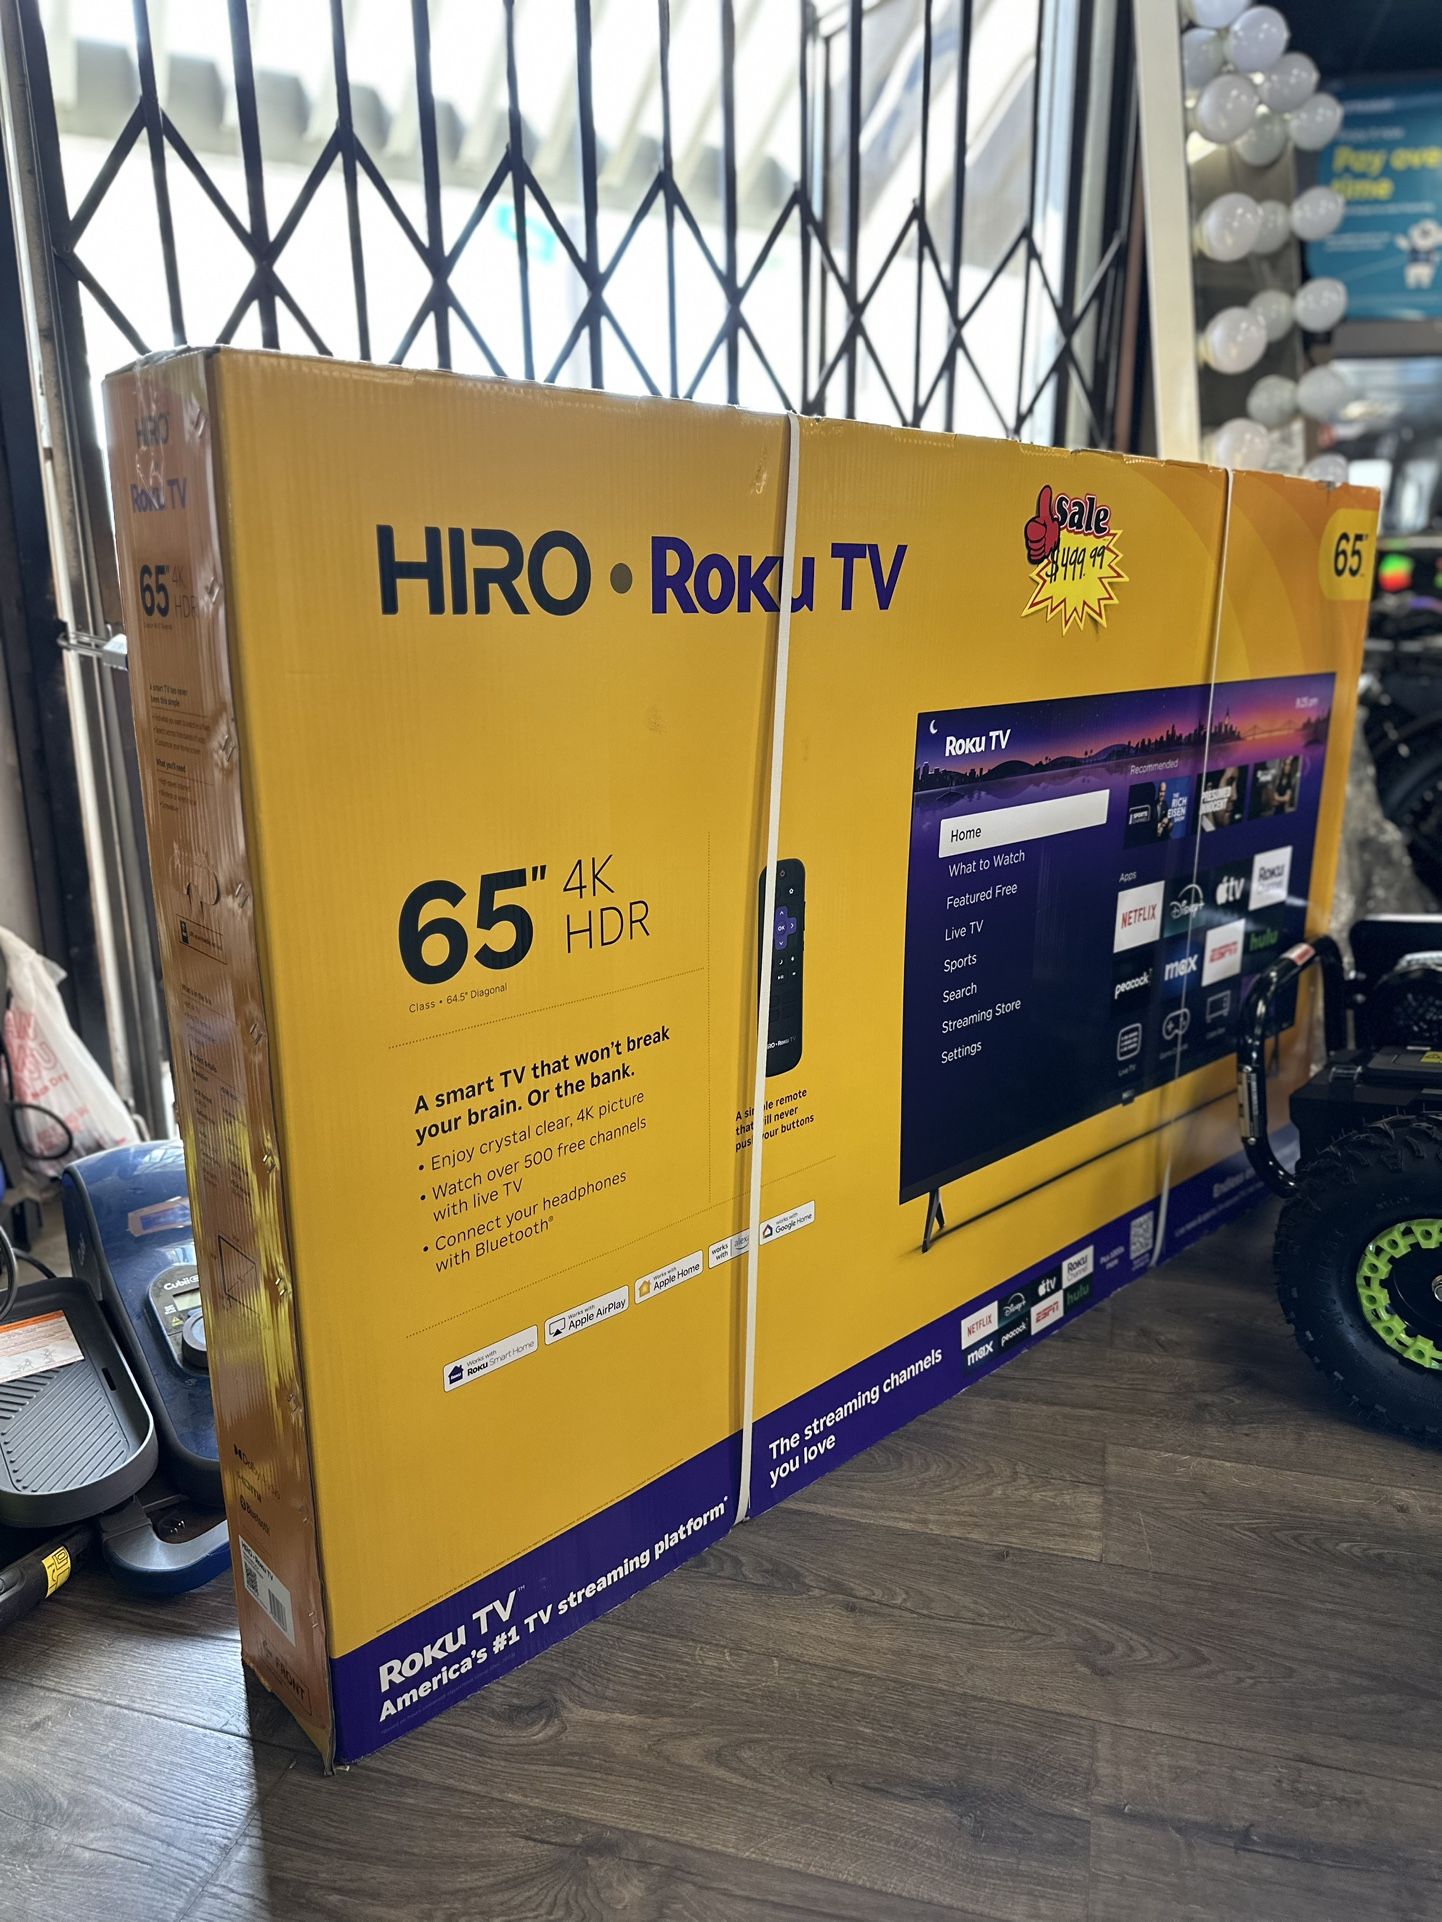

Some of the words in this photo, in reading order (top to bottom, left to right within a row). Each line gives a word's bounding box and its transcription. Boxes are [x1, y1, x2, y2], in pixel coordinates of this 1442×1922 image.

[1333, 146, 1386, 177] Pay
[1391, 145, 1442, 171] ove
[167, 477, 187, 510] TV
[172, 565, 186, 588] 4K
[376, 524, 591, 616] HIRO
[651, 536, 815, 615] Roku
[831, 542, 908, 611] TV
[944, 735, 985, 756] Roku
[989, 729, 1011, 751] TV
[1129, 759, 1179, 776] Recommended
[1167, 806, 1186, 819] EISEN
[1171, 796, 1187, 808] RICH
[951, 826, 981, 843] Home
[949, 859, 976, 877] What
[979, 858, 990, 870] to
[993, 849, 1025, 868] Watch
[1119, 870, 1137, 883] Apps
[1258, 864, 1285, 882] Roku
[946, 889, 992, 910] Featured
[995, 883, 1018, 898] Free
[398, 864, 547, 985] 65"
[563, 854, 615, 899] 4K
[566, 900, 650, 953] HDR
[1121, 903, 1157, 929] NETFLIX
[945, 926, 966, 941] Live
[969, 919, 984, 935] TV
[1250, 927, 1278, 950] hulu
[943, 954, 977, 973] Sports
[1209, 941, 1238, 964] ESPN
[1164, 954, 1198, 981] max
[409, 998, 436, 1013] Class
[470, 982, 508, 999] Diagonal
[942, 982, 977, 1003] Search
[1115, 972, 1150, 999] peacock
[941, 1008, 993, 1034] Streaming
[995, 1000, 1021, 1016] Store
[941, 1041, 982, 1064] Settings
[414, 1095, 429, 1114] A
[435, 1075, 495, 1108] smart
[500, 1066, 526, 1088] TV
[531, 1054, 570, 1080] that
[575, 1041, 622, 1067] won't
[626, 1025, 670, 1053] break
[415, 1114, 462, 1146] your
[467, 1097, 523, 1126] brain.
[527, 1087, 551, 1107] Or
[555, 1078, 585, 1099] the
[590, 1062, 635, 1089] bank.
[735, 1111, 742, 1121] A
[744, 1101, 773, 1118] sile
[776, 1088, 807, 1106] remote
[774, 1106, 799, 1123] never
[431, 1146, 475, 1171] Enjoy
[479, 1125, 531, 1156] crystal
[535, 1115, 574, 1137] clear,
[576, 1105, 595, 1122] 4K
[598, 1090, 645, 1119] picture
[735, 1136, 754, 1152] pus
[781, 1114, 815, 1133] buttons
[432, 1173, 482, 1200] Watch
[487, 1161, 520, 1182] over
[524, 1147, 553, 1170] 500
[557, 1138, 586, 1158] free
[589, 1116, 647, 1148] channels
[432, 1197, 468, 1222] with
[473, 1187, 499, 1208] live
[503, 1177, 524, 1196] TV
[435, 1214, 502, 1251] Connect
[505, 1201, 539, 1228] your
[542, 1170, 627, 1210] headphones
[775, 1220, 796, 1234] Google
[797, 1212, 813, 1225] Home
[435, 1247, 471, 1273] with
[711, 1243, 729, 1255] works
[715, 1250, 729, 1260] with
[653, 1273, 676, 1291] Apple
[677, 1262, 700, 1279] Home
[1067, 1255, 1088, 1274] Roku
[1067, 1284, 1089, 1304] hulu
[568, 1312, 594, 1331] Apple
[595, 1297, 626, 1320] AirPlay
[967, 1314, 992, 1338] NETFLIX
[1035, 1301, 1059, 1324] ESPN
[1001, 1321, 1027, 1347] peacock
[466, 1355, 484, 1367] Works
[485, 1350, 497, 1360] with
[467, 1361, 489, 1377] Roku
[489, 1350, 511, 1366] Smart
[512, 1340, 535, 1356] Home
[967, 1340, 994, 1366] max
[769, 1430, 800, 1460] The
[804, 1384, 880, 1440] streaming
[882, 1348, 942, 1393] channels
[769, 1456, 800, 1488] you
[803, 1434, 836, 1465] love
[379, 1647, 488, 1722] America's
[492, 1626, 520, 1654] #1
[524, 1603, 553, 1633] TV
[557, 1548, 650, 1615] streaming
[379, 1624, 466, 1693] Roku
[275, 1656, 305, 1700] FRONT
